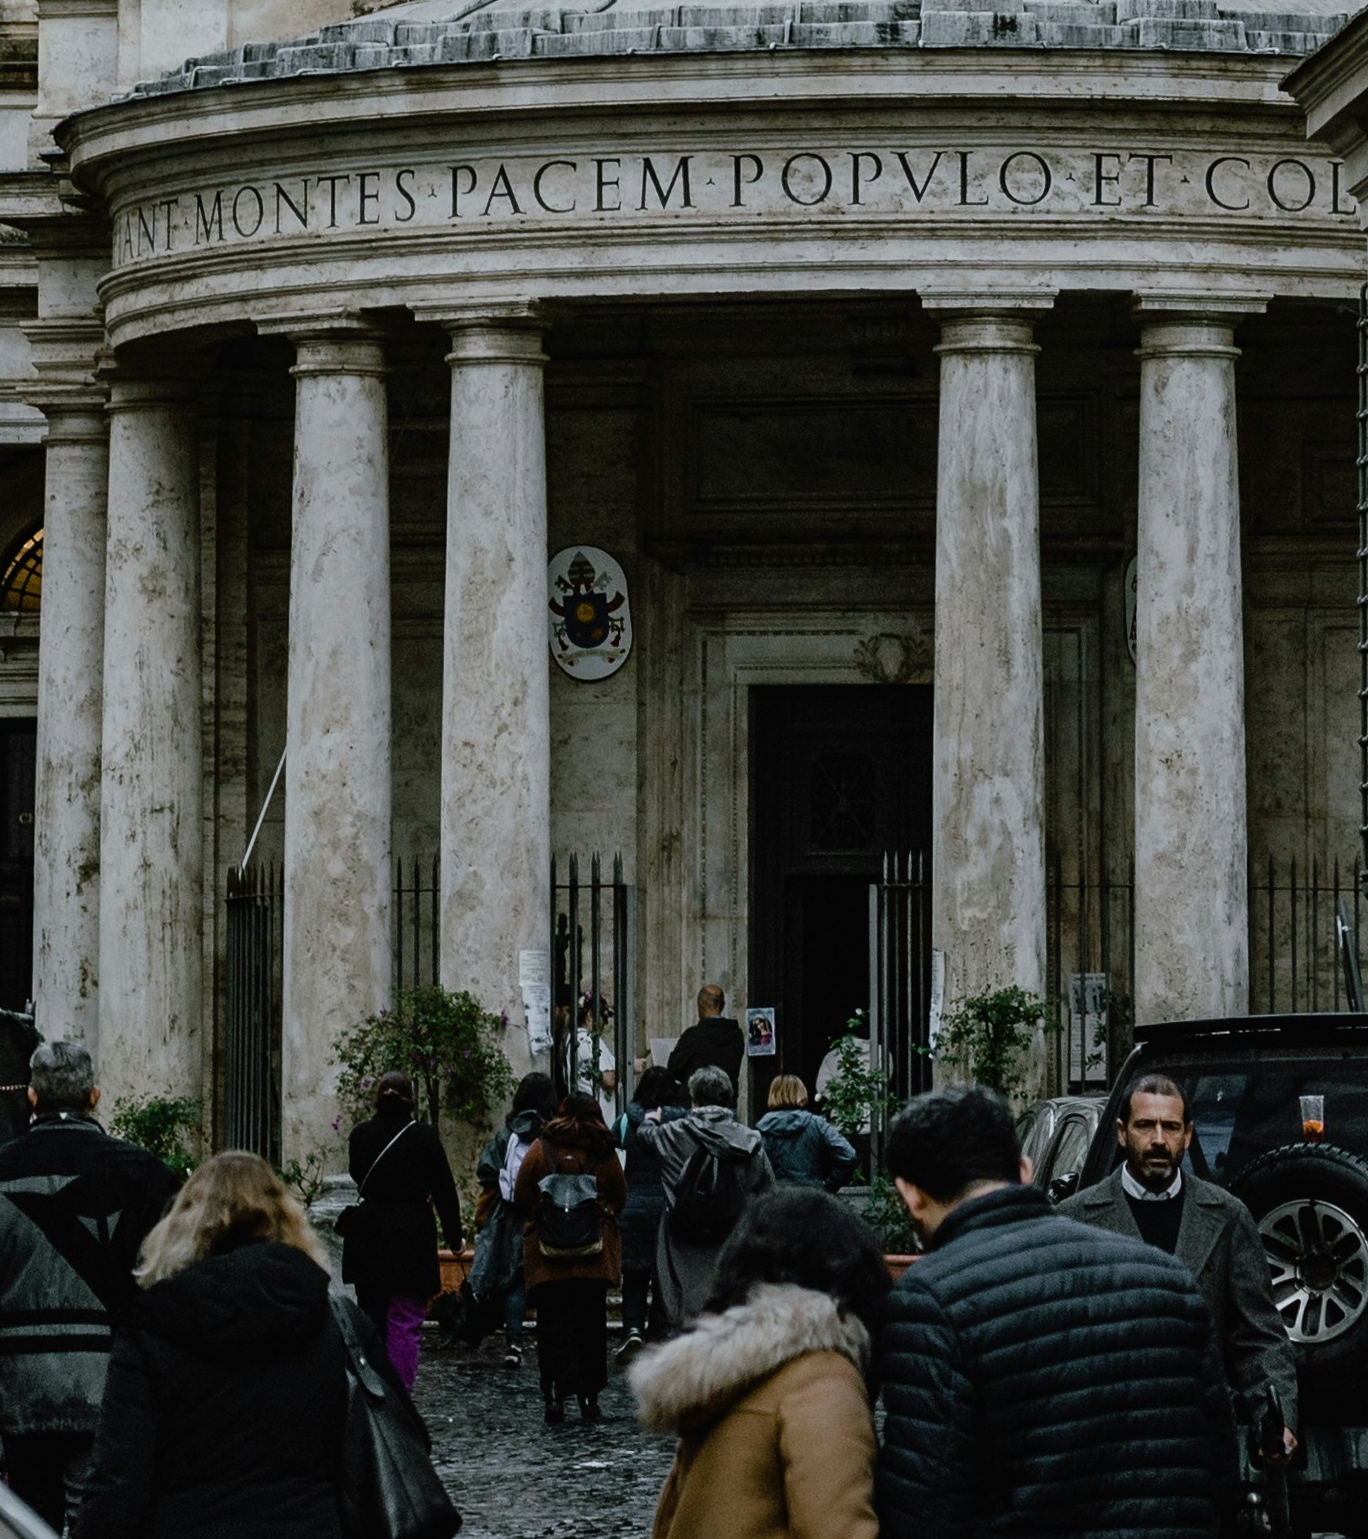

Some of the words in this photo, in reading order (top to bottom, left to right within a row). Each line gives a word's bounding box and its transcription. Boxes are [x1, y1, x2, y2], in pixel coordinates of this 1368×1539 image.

[195, 168, 417, 245] MONTES
[448, 154, 698, 219] PACEM
[729, 150, 1053, 208] POPVLO
[1089, 152, 1173, 208] ET
[1204, 156, 1358, 215] COL
